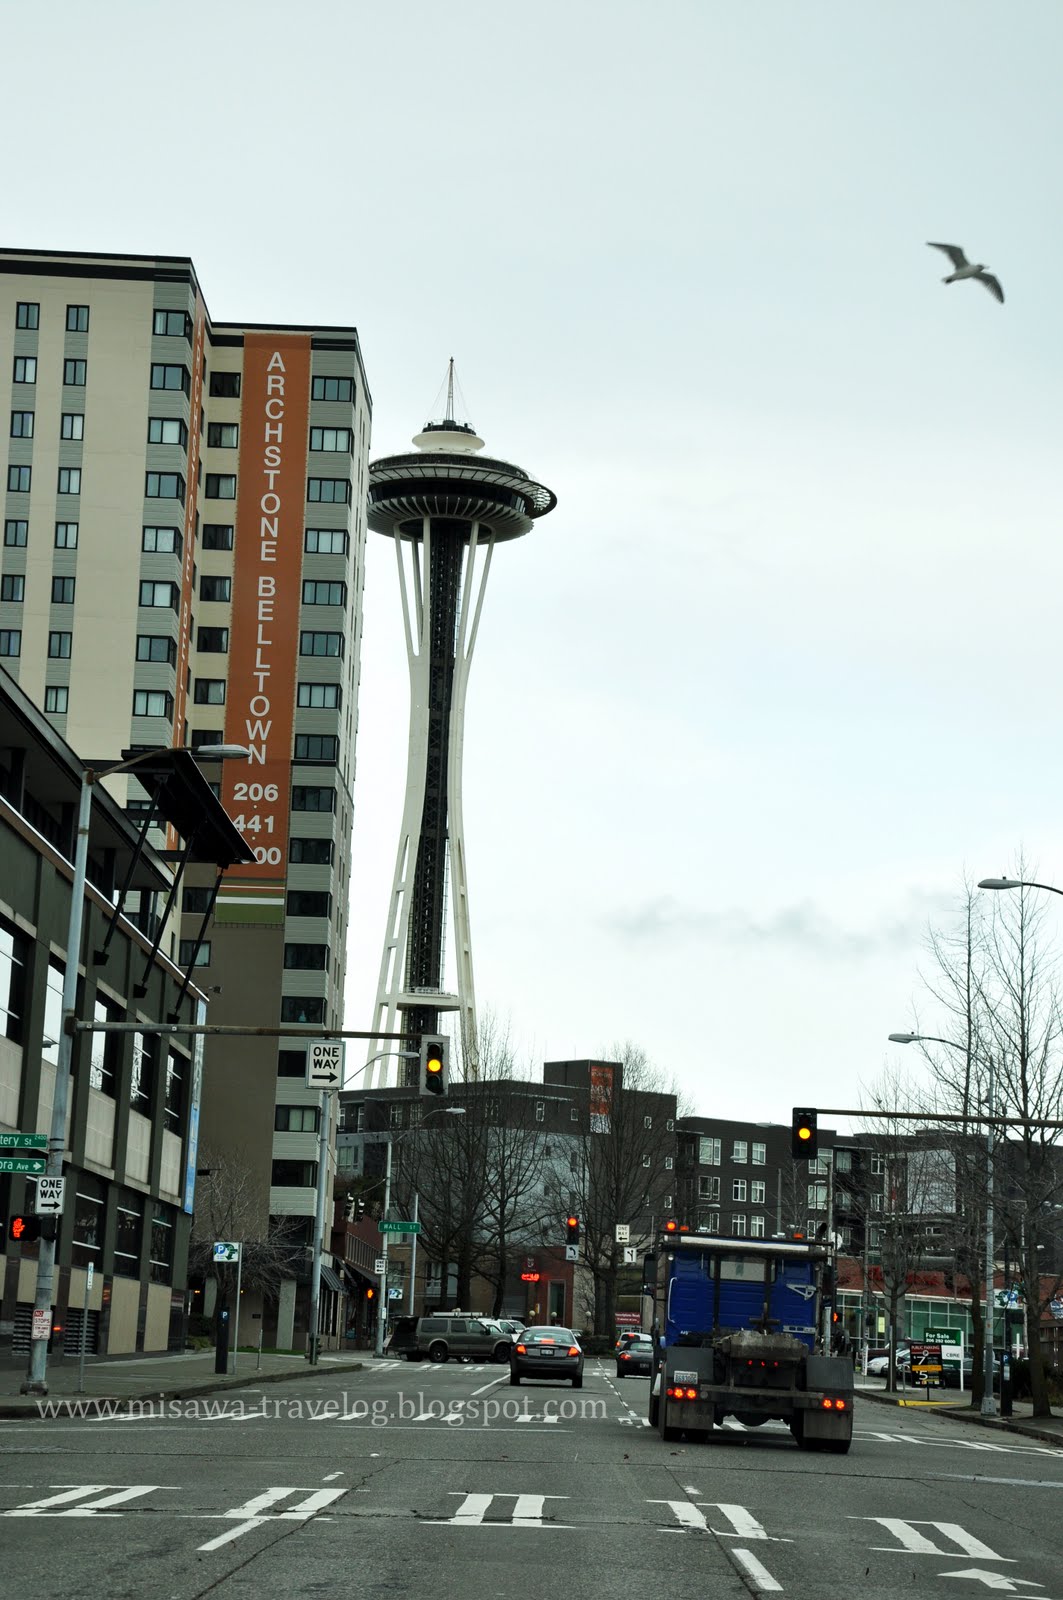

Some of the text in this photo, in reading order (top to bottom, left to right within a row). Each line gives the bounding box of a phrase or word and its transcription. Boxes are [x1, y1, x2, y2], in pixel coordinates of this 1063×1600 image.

[246, 351, 286, 765] ARCHSTONE BELLTOWN
[233, 783, 279, 802] 206
[232, 814, 275, 833] 441
[313, 1046, 340, 1058] ONE
[313, 1058, 340, 1070] WAY
[24, 1137, 32, 1146] St
[16, 1162, 29, 1171] Ave
[40, 1179, 62, 1189] ONE
[40, 1189, 62, 1199] WAY
[222, 1311, 228, 1319] P
